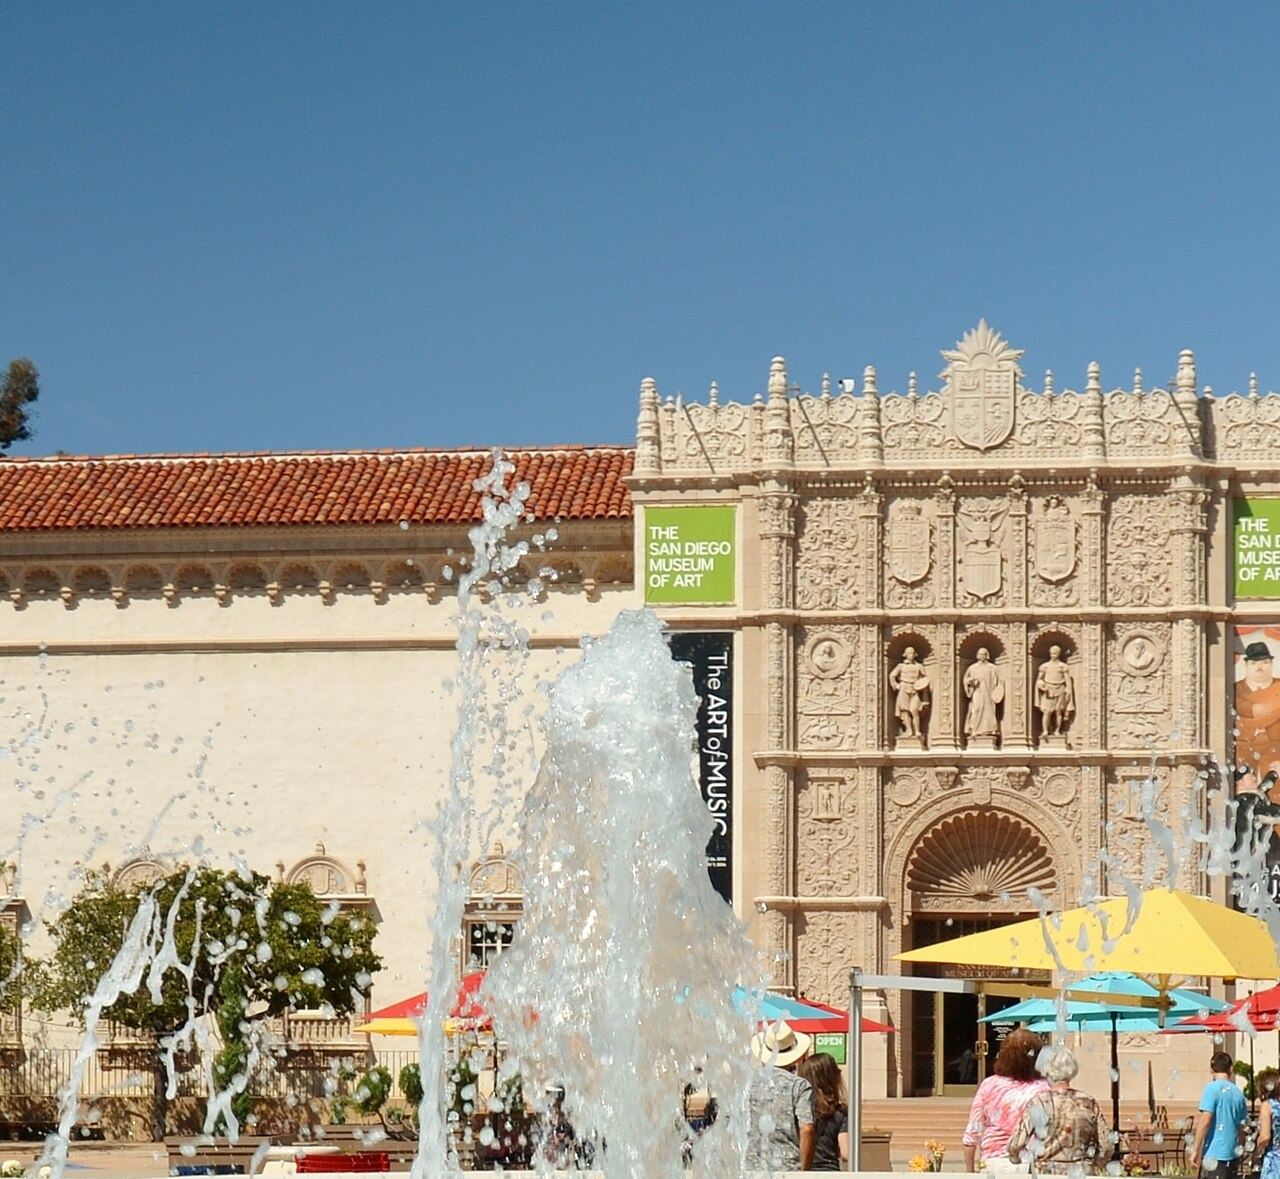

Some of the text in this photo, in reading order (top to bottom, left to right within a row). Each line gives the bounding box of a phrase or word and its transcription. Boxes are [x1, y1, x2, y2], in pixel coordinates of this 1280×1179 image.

[1238, 518, 1269, 532] THE
[649, 526, 679, 540] THE
[649, 541, 731, 555] SAN DIEGO
[1239, 534, 1271, 548] SAN
[649, 558, 714, 571] MUSEUM
[649, 574, 704, 587] OF ART
[1239, 567, 1260, 581] OF
[708, 651, 728, 690] The
[707, 694, 727, 738] ART
[702, 737, 728, 760] of
[816, 1037, 843, 1046] OPEN
